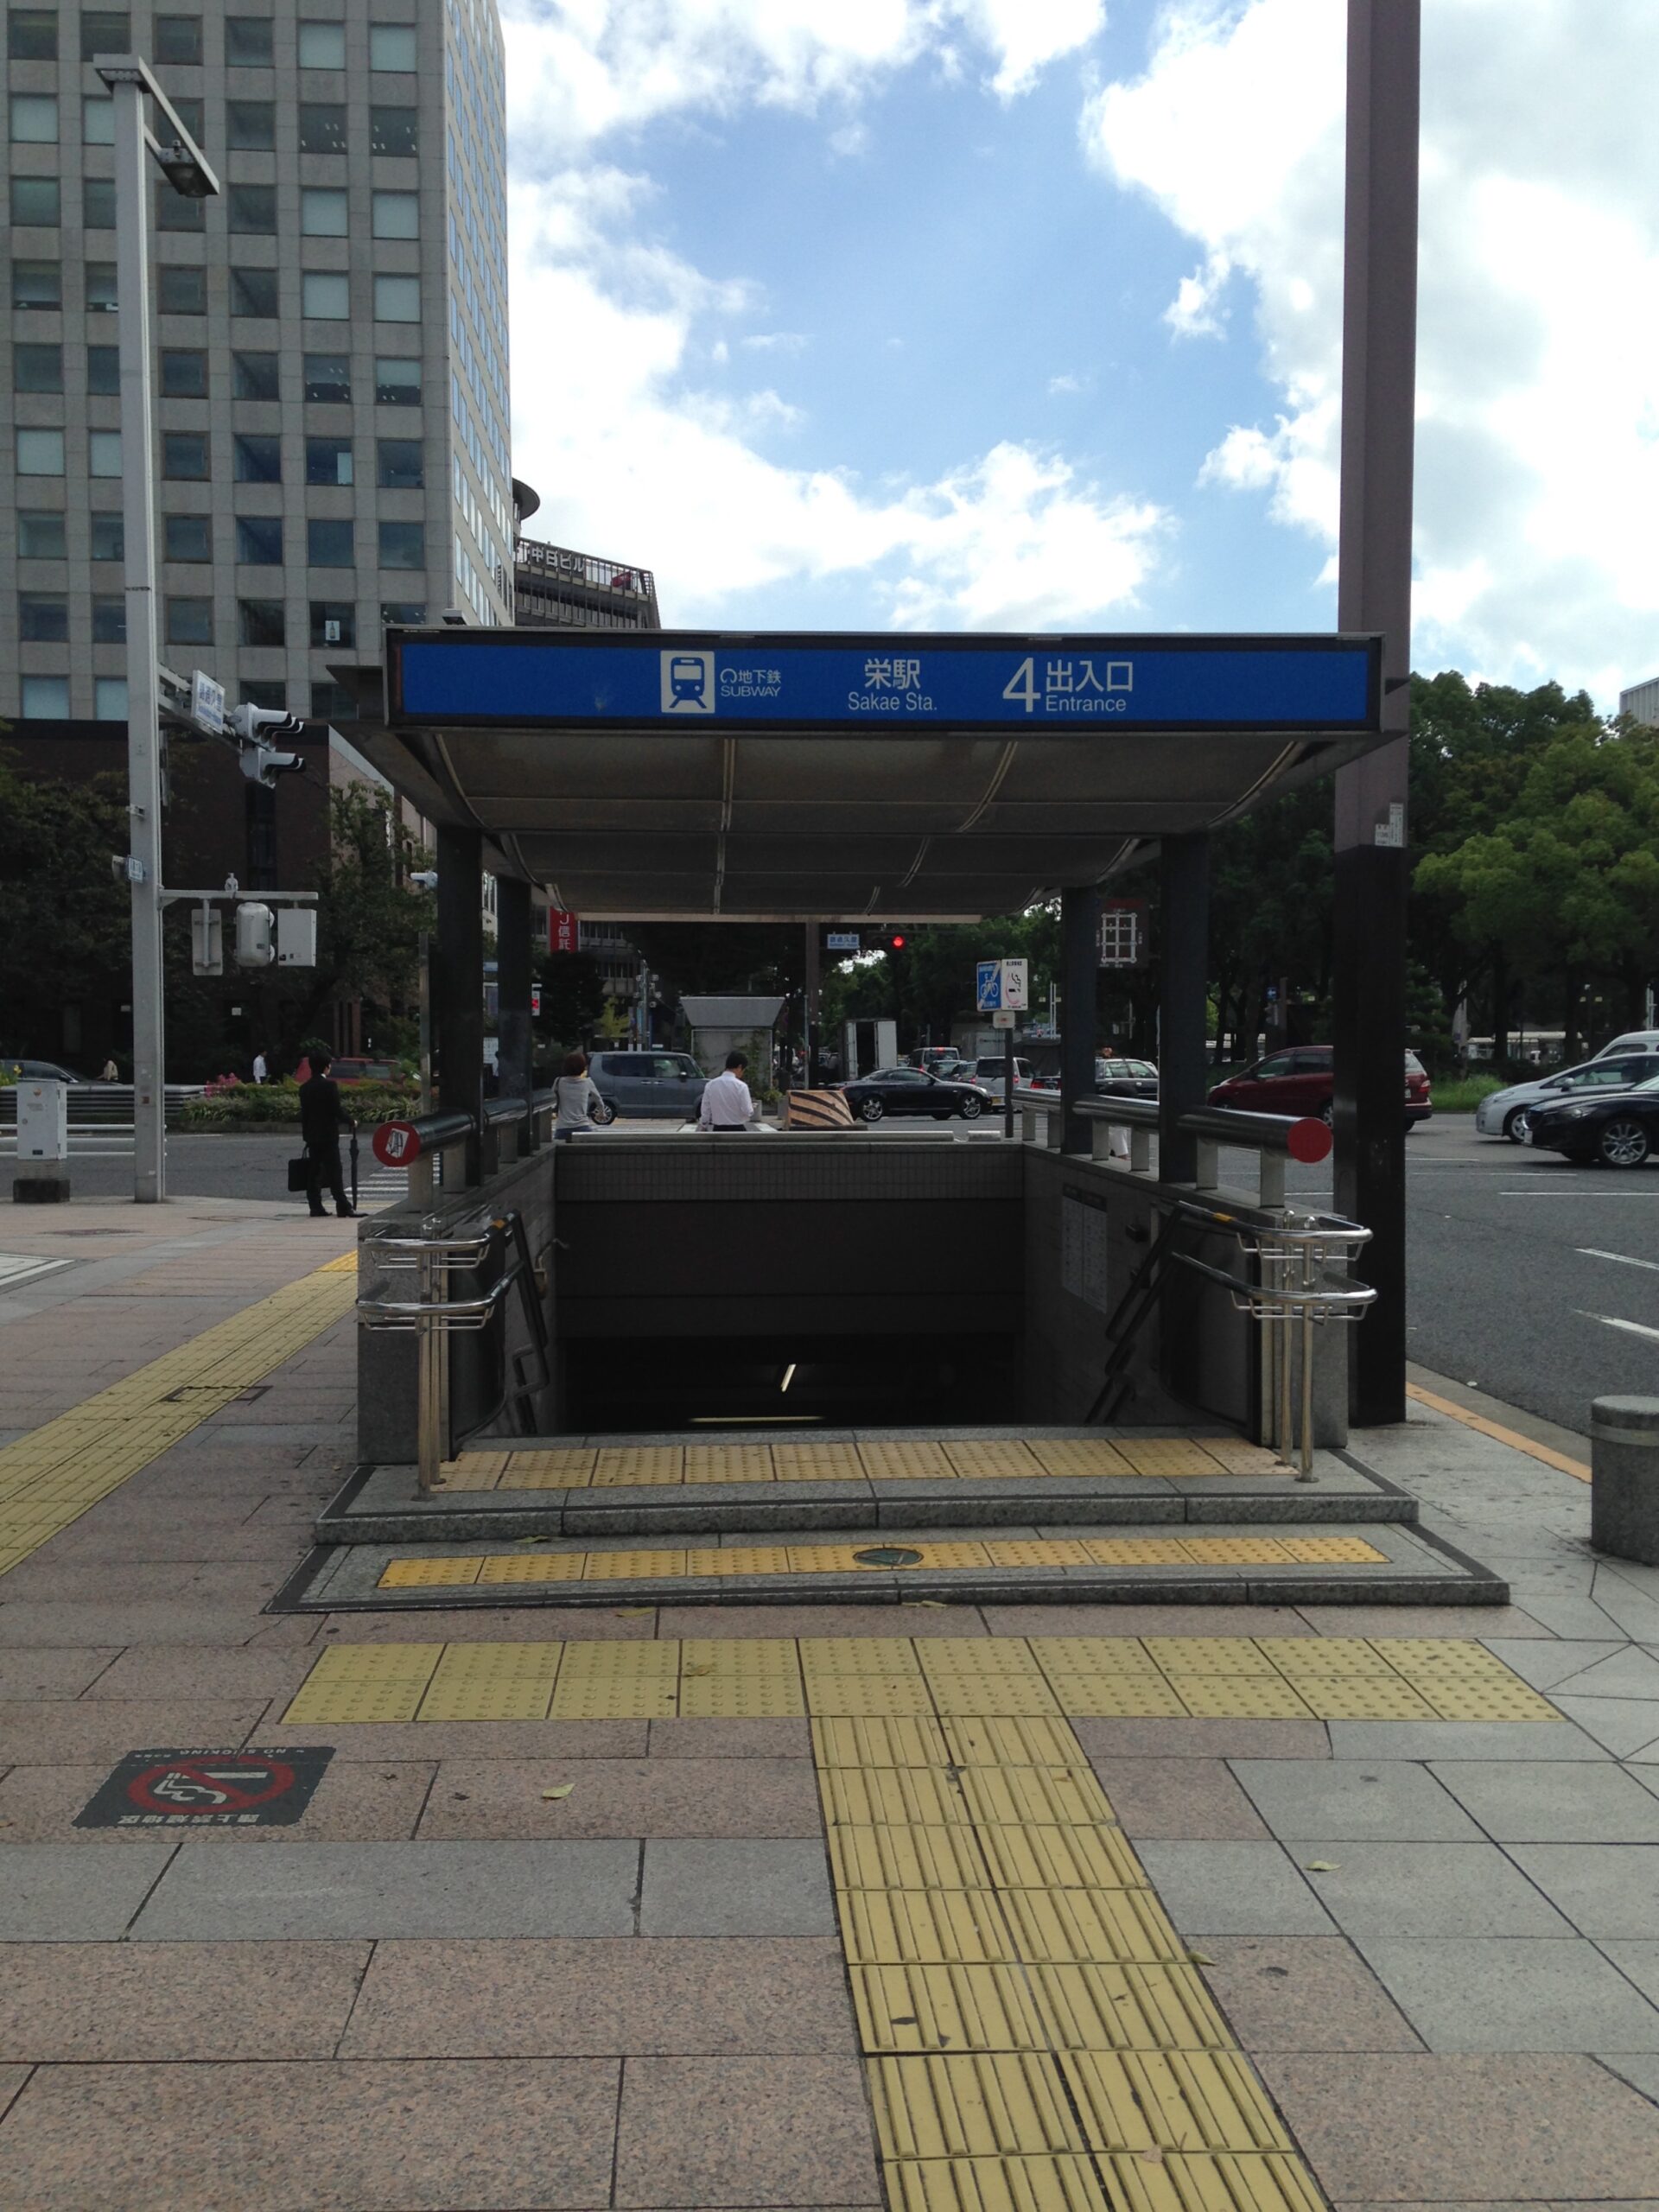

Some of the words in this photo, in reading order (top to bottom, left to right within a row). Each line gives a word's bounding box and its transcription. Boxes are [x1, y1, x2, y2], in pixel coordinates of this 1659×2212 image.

[531, 546, 585, 572] 中日ビル
[738, 669, 781, 684] 地下鉄
[864, 658, 920, 690] 栄駅
[1002, 658, 1041, 712] 4
[1046, 659, 1134, 692] 出入口
[720, 685, 781, 697] SUBWAY
[849, 691, 900, 710] Sakae
[906, 692, 938, 711] Sta.
[1046, 695, 1127, 712] Entrance
[558, 912, 571, 950] J信託
